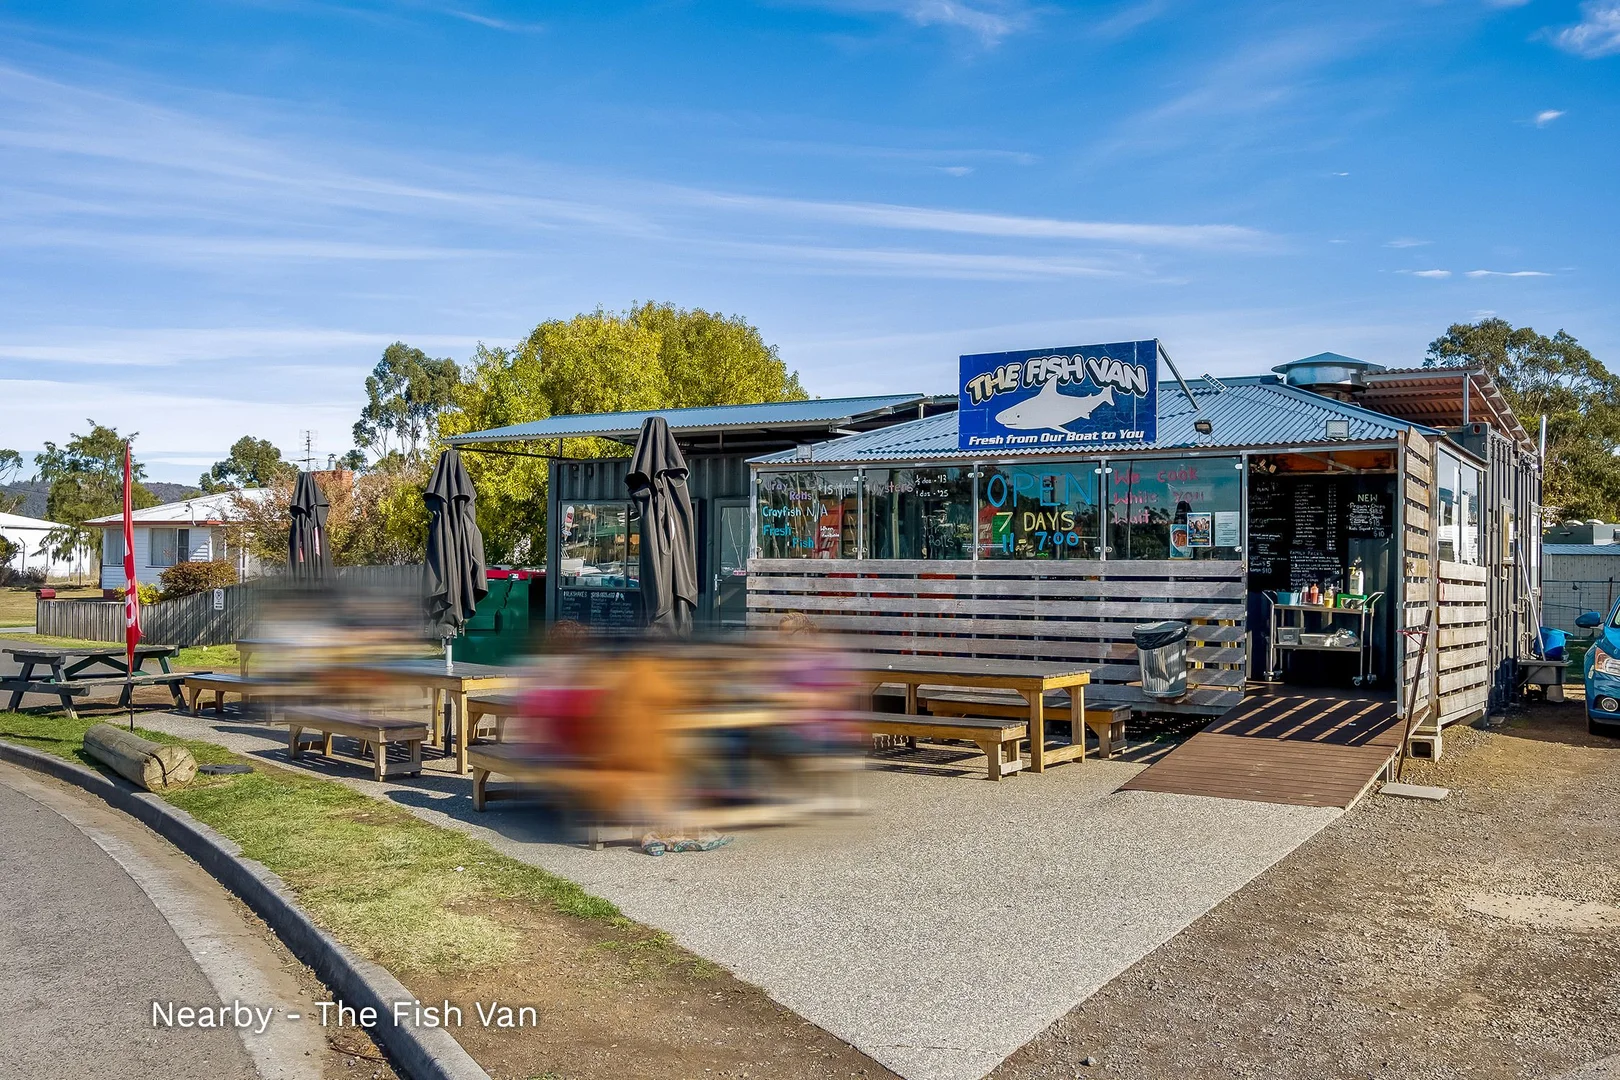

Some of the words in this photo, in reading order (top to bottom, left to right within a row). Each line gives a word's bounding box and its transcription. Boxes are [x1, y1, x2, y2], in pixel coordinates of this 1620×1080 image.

[966, 362, 1022, 405] THE
[1023, 354, 1084, 388] FISH
[1085, 356, 1149, 397] VAN
[968, 435, 1004, 446] Fresh
[1006, 434, 1039, 444] from
[1040, 432, 1066, 443] Our
[1066, 431, 1098, 442] Boat
[1101, 430, 1116, 440] to
[1119, 429, 1145, 440] You
[1114, 468, 1141, 485] We
[1157, 466, 1199, 483] cook
[987, 471, 1093, 508] OPEN
[1357, 493, 1378, 503] NEW
[762, 506, 802, 517] Crayfish
[763, 523, 792, 536] Fresh
[996, 511, 1014, 533] 7
[1023, 511, 1076, 532] DAYS
[792, 536, 815, 549] Fish
[1035, 531, 1079, 551] 7:00
